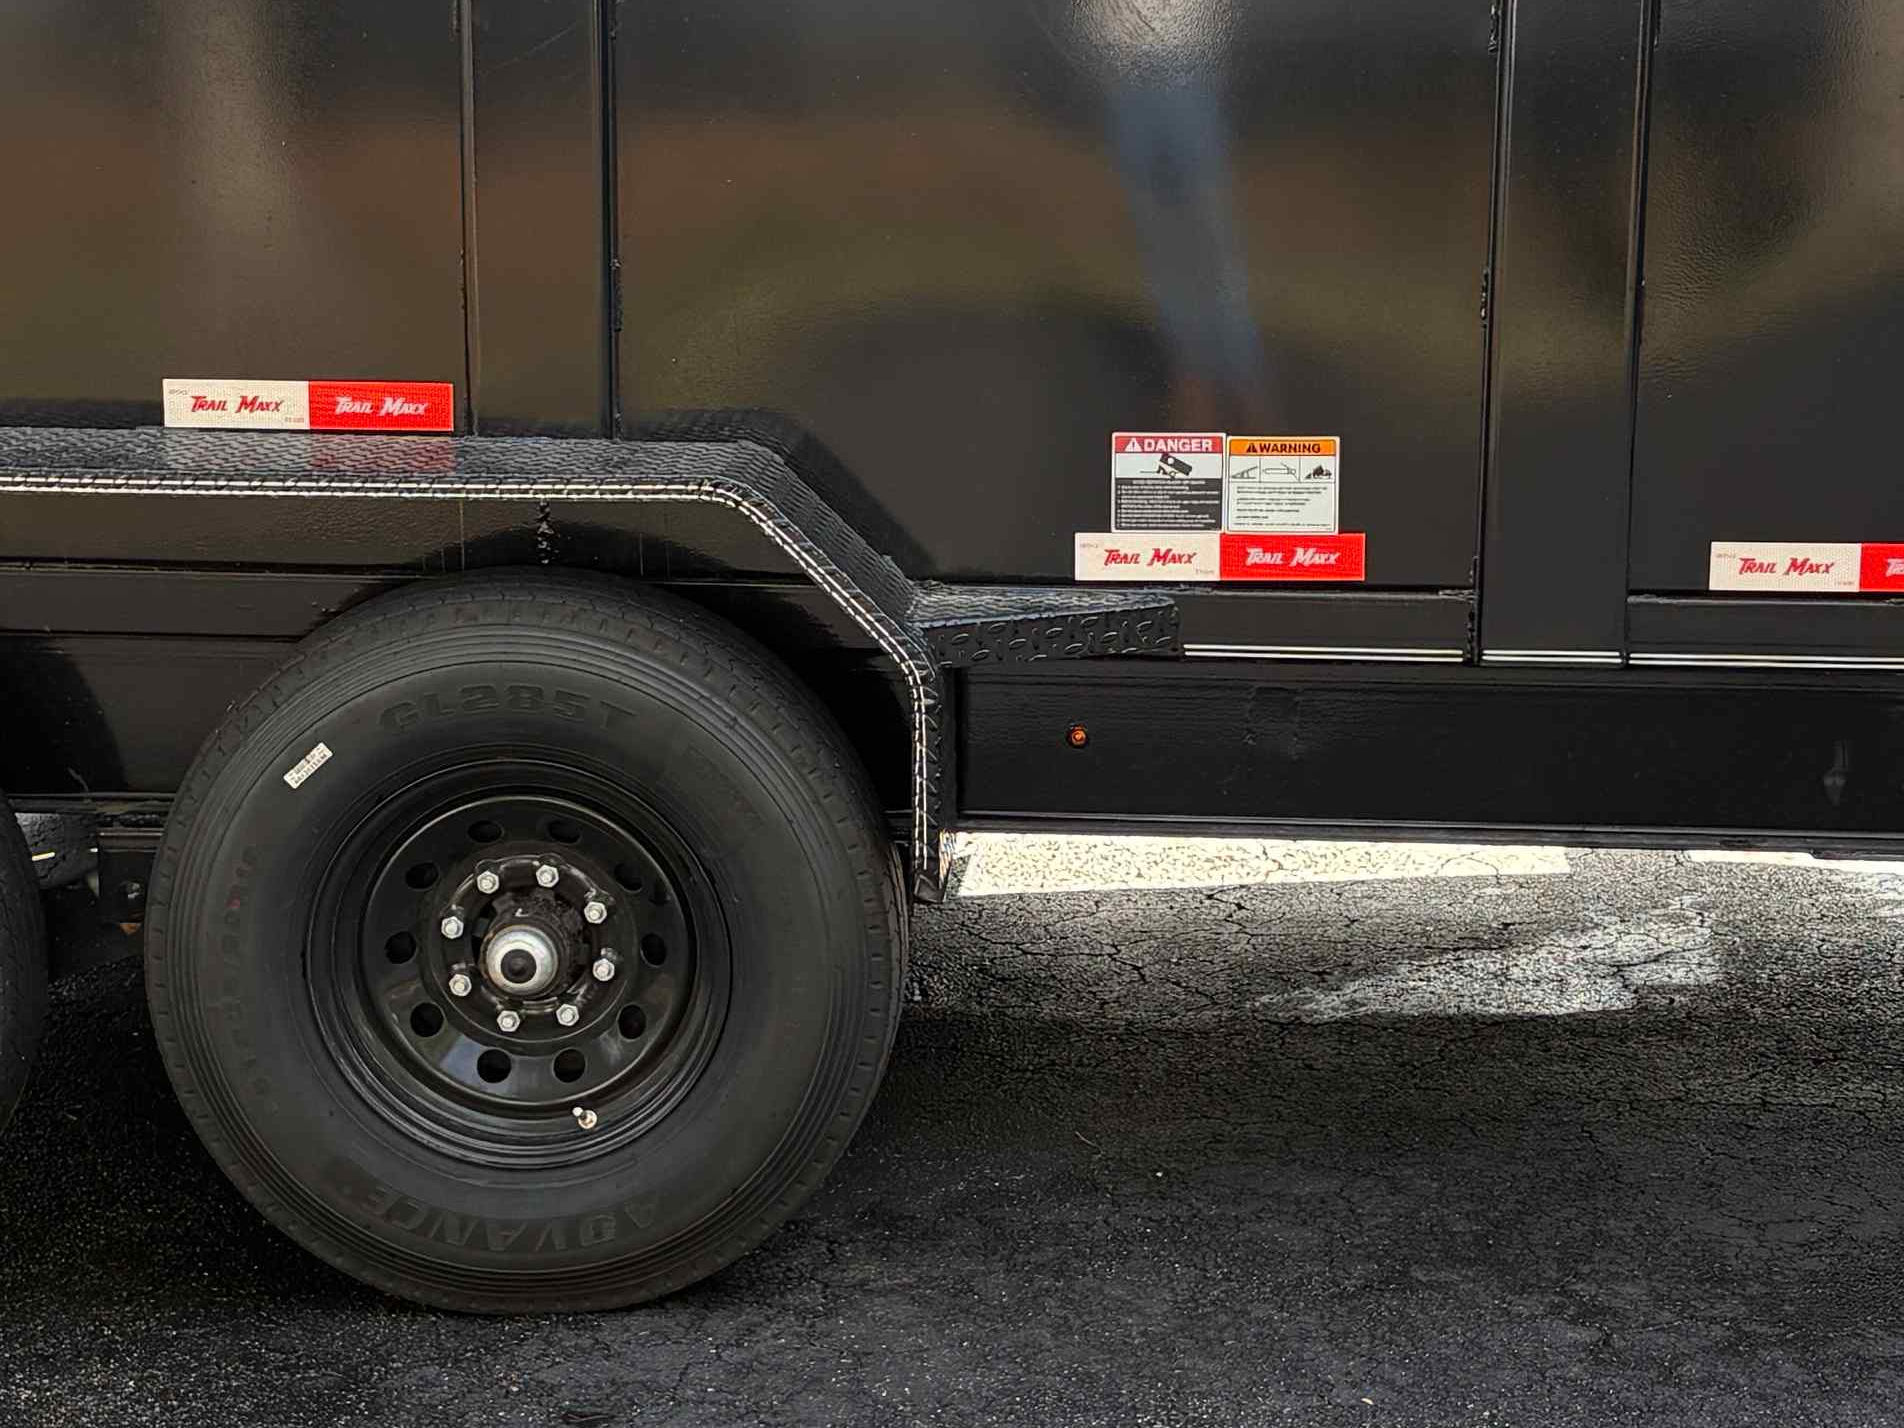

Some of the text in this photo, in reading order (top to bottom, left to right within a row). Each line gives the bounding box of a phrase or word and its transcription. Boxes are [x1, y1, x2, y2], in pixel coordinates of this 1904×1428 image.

[1143, 438, 1213, 452] DANGER
[1259, 443, 1321, 453] WARNING
[376, 681, 639, 732] GL285T
[362, 1183, 663, 1254] ADVANCE
